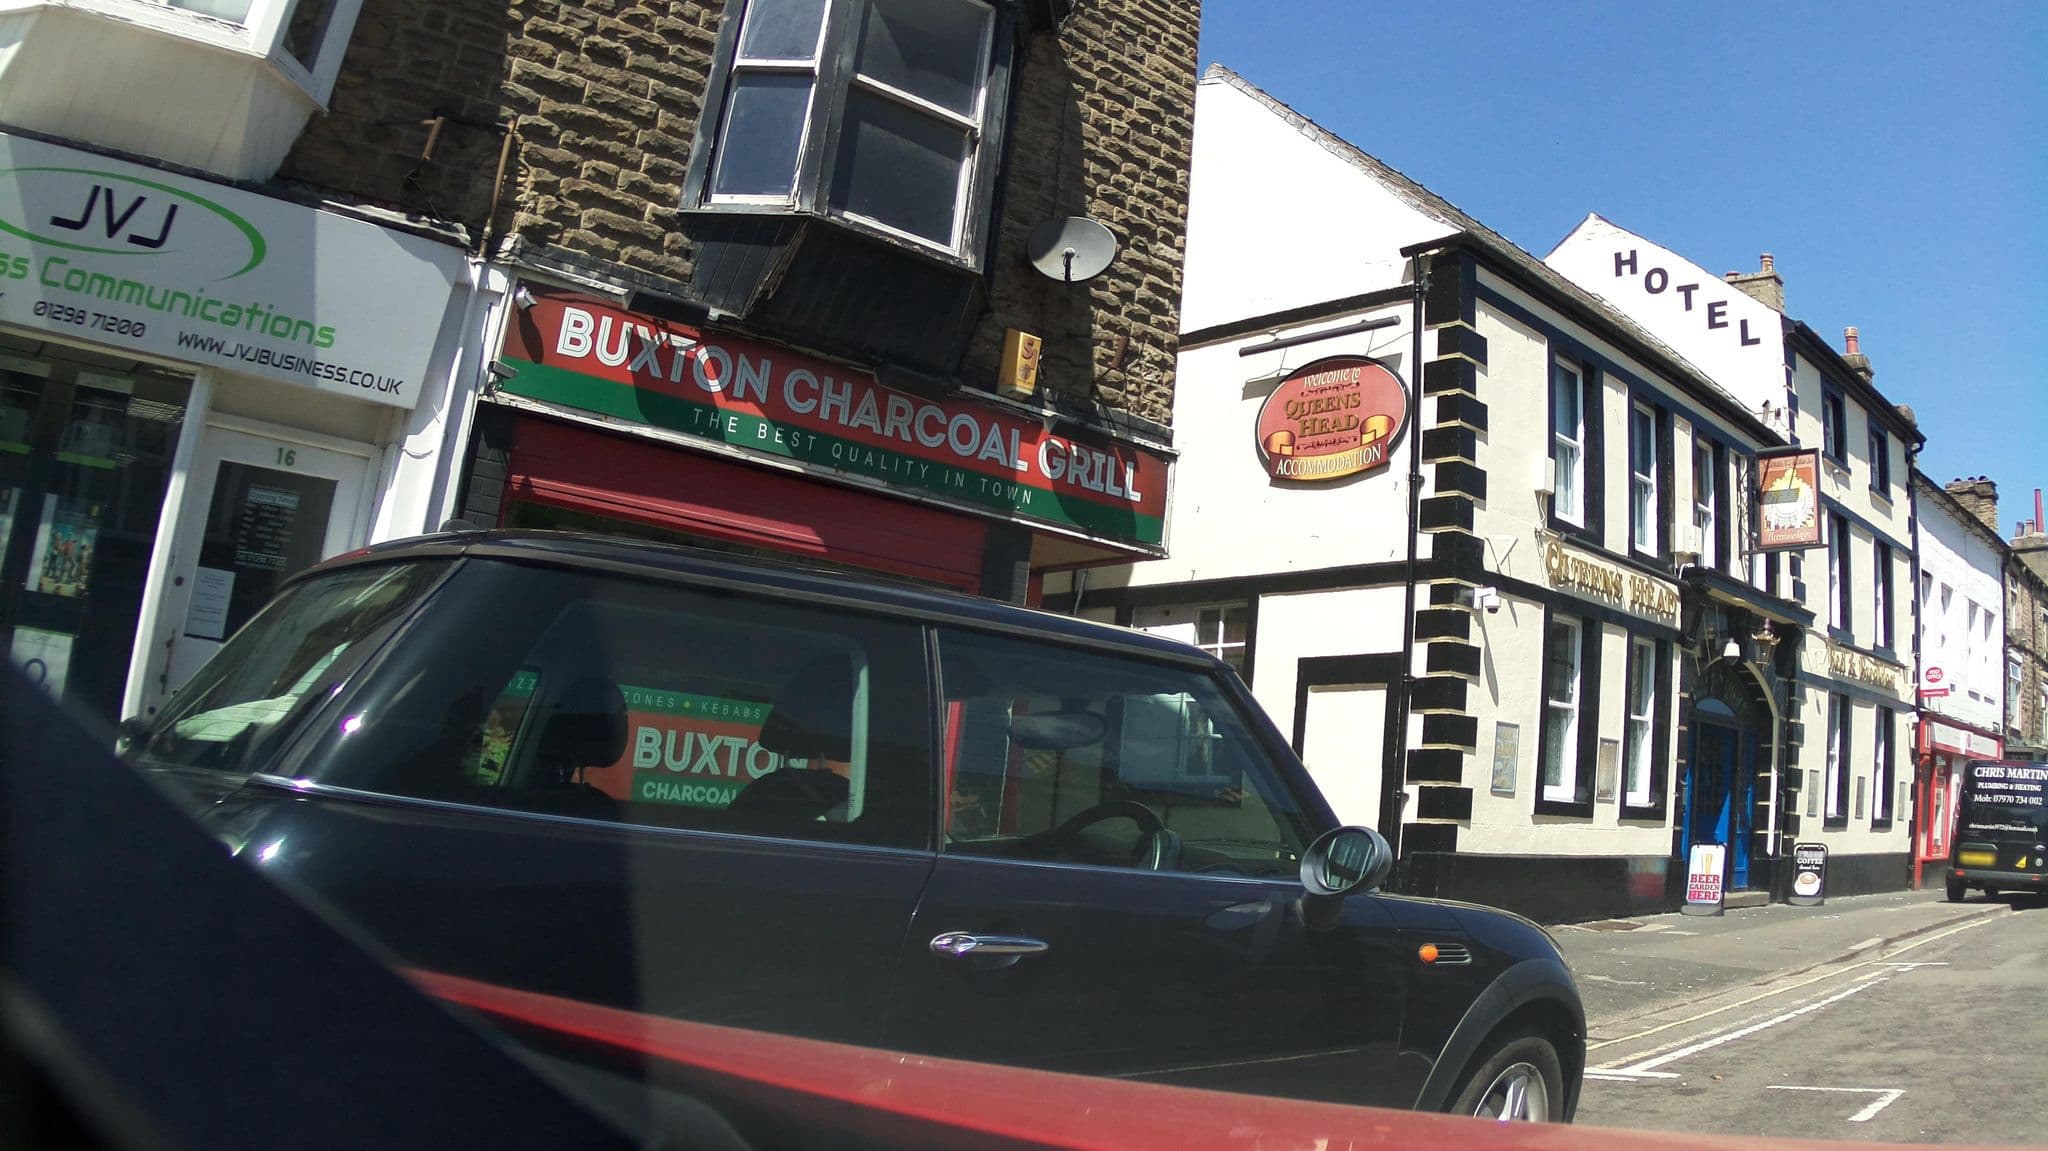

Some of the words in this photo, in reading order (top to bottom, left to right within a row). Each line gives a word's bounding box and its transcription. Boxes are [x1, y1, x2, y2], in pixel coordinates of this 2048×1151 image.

[50, 185, 178, 249] JVJ
[40, 256, 336, 348] Communications
[1614, 249, 1760, 346] HOTEL
[33, 301, 87, 325] 01298
[91, 313, 145, 338] 71200
[178, 330, 403, 395] WWW.JVJBUSINESS.CO.UK
[556, 307, 772, 404] BUXTON
[784, 369, 1028, 472] CHARCOAL
[1038, 438, 1141, 502] GRILL
[1284, 392, 1361, 420] QUEENS
[1299, 414, 1360, 437] HEAD
[276, 447, 296, 467] 16
[693, 408, 738, 433] THE
[758, 423, 816, 451] BEST
[832, 443, 929, 478] QUALITY
[945, 470, 964, 486] IN
[981, 478, 1032, 505] TOWN
[1276, 444, 1381, 476] ACCOMMODATION
[701, 702, 761, 718] KEBABS
[1974, 767, 2005, 778] CHRIS
[2006, 768, 2048, 780] MARTIN
[1977, 782, 2009, 790] PLUMBING
[1690, 874, 1720, 884] BEER
[1688, 891, 1719, 901] HERE
